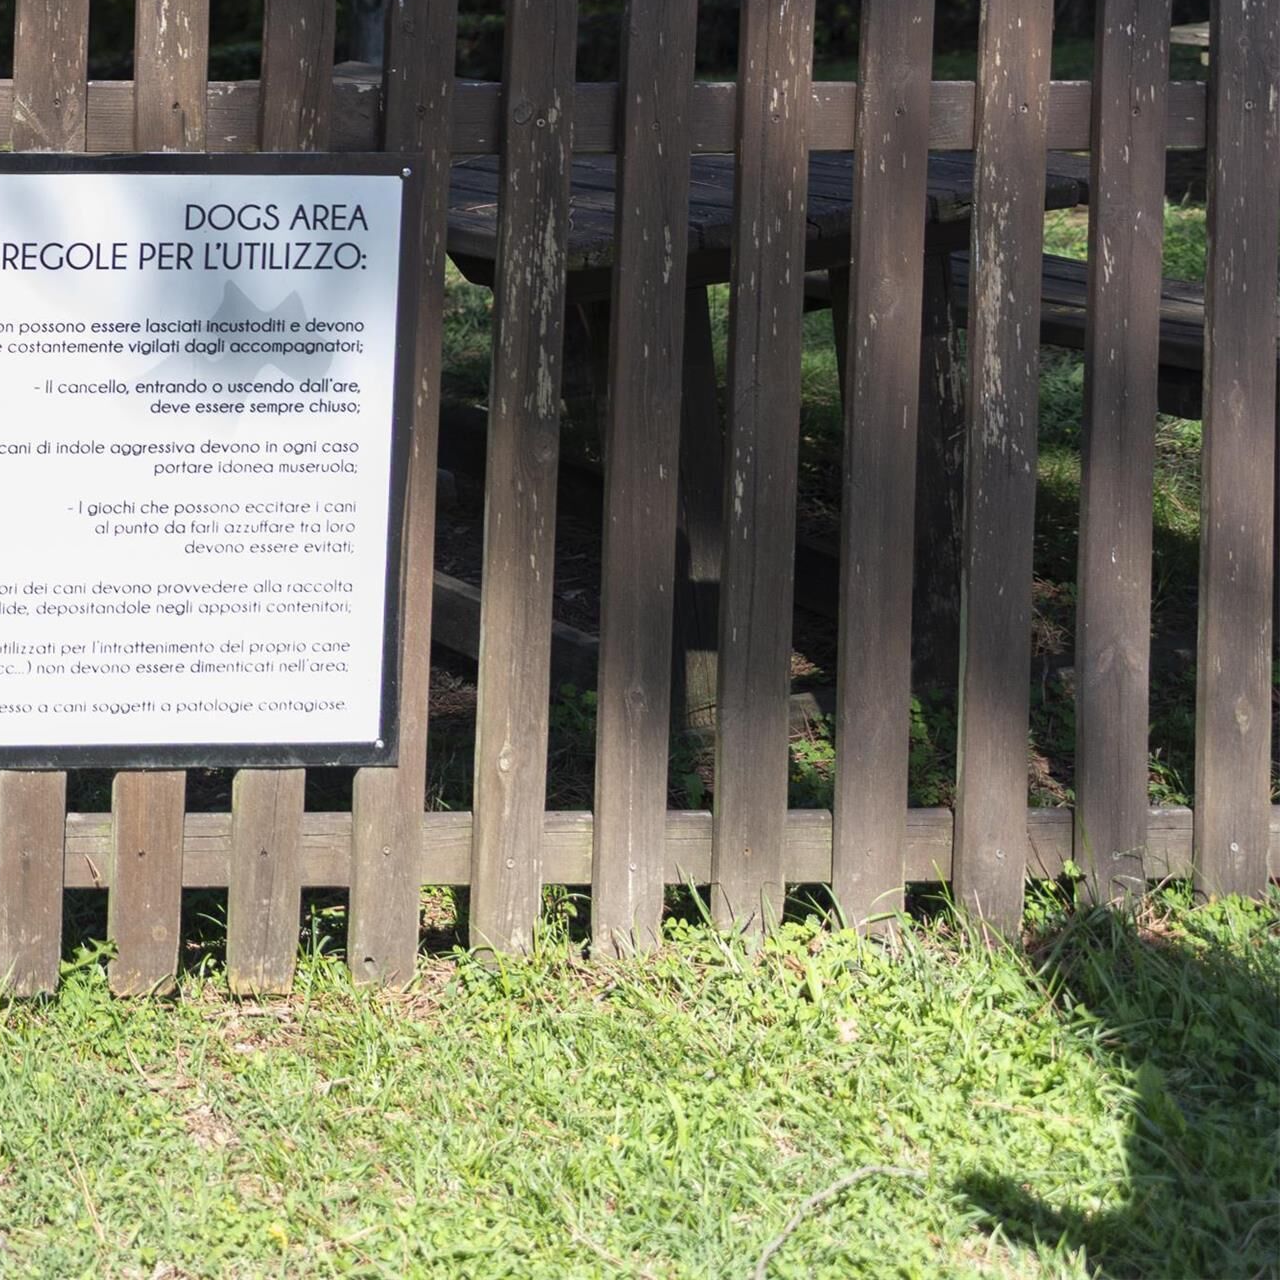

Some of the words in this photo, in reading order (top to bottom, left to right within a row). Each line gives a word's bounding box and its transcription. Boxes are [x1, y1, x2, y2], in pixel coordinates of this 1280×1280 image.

[185, 203, 280, 232] DOGS
[289, 203, 368, 232] AREA
[2, 242, 128, 271] REGOLE
[139, 242, 194, 271] PER
[204, 242, 367, 271] L'UTILIZZO:
[19, 322, 86, 336] possono
[90, 322, 141, 333] essere
[145, 318, 202, 333] lasciati
[206, 318, 286, 333] incustoditi
[290, 321, 300, 333] e
[305, 318, 364, 333] devono
[7, 340, 123, 353] costantemente
[128, 338, 180, 356] vigilati
[184, 338, 225, 356] dagli
[229, 340, 364, 356] accompagnatori;
[45, 379, 52, 394] Il
[57, 379, 130, 396] cancello,
[135, 379, 207, 394] entrando
[212, 382, 222, 393] o
[228, 378, 294, 393] uscendo
[150, 399, 190, 413] deve
[195, 402, 244, 413] essere
[249, 402, 304, 416] sempre
[309, 398, 360, 415] chiuso;
[36, 440, 51, 455] di
[56, 440, 104, 454] indole
[110, 441, 195, 457] aggressiva
[200, 439, 261, 454] devono
[265, 440, 278, 453] in
[283, 440, 317, 456] ogni
[322, 442, 359, 453] caso
[154, 461, 212, 477] portare
[218, 459, 273, 474] idonea
[279, 458, 358, 475] museruola;
[79, 500, 82, 515] I
[87, 500, 135, 517] giochi
[140, 499, 169, 514] che
[174, 503, 240, 517] possono
[245, 500, 310, 513] eccitare
[316, 500, 319, 513] i
[324, 500, 356, 513] cani
[95, 520, 109, 535] al
[114, 521, 159, 537] punto
[164, 519, 186, 534] da
[190, 519, 218, 534] farli
[224, 519, 295, 534] azzuffare
[300, 520, 321, 533] tra
[326, 518, 356, 533] loro
[184, 539, 244, 554] devono
[250, 542, 299, 553] essere
[304, 540, 354, 555] evitati;
[23, 580, 48, 595] dei
[53, 581, 86, 595] cani
[92, 580, 151, 594] devono
[157, 579, 248, 597] provvedere
[253, 579, 282, 593] alla
[287, 578, 353, 593] raccolta
[36, 600, 151, 618] depositandole
[156, 599, 193, 617] negli
[198, 600, 261, 617] appositi
[266, 600, 351, 615] contenitori;
[61, 643, 86, 657] per
[92, 639, 215, 654] l'intrattenimento
[220, 638, 244, 653] del
[249, 640, 306, 656] proprio
[312, 641, 350, 652] cane
[37, 663, 65, 674] non
[70, 659, 130, 674] devono
[136, 662, 185, 674] essere
[190, 658, 274, 673] dimenticati
[279, 658, 349, 674] nell'area;
[37, 702, 49, 713] a
[53, 700, 86, 713] cani
[92, 699, 155, 716] soggetti
[161, 701, 171, 712] a
[176, 697, 253, 715] patologie
